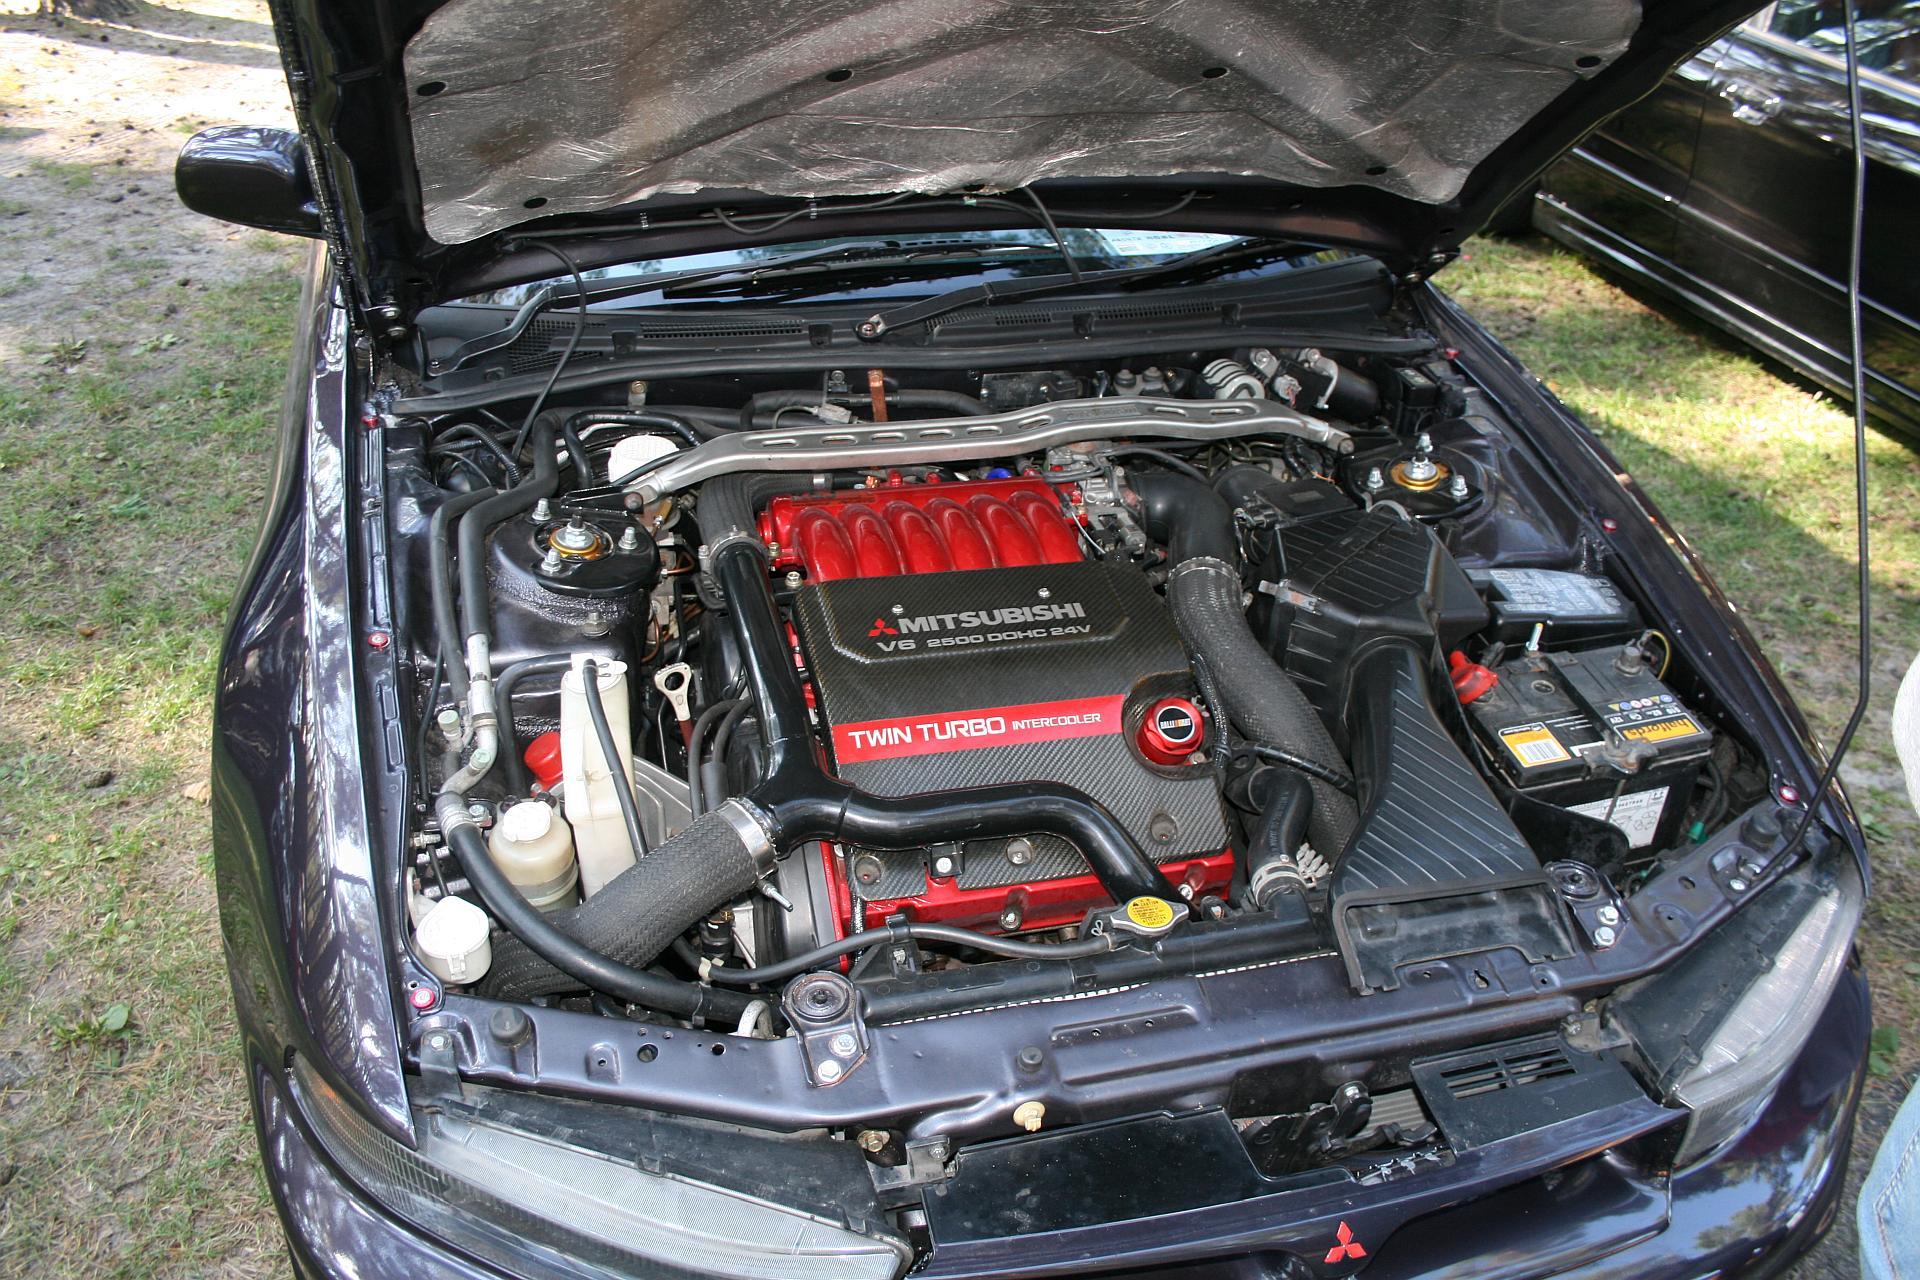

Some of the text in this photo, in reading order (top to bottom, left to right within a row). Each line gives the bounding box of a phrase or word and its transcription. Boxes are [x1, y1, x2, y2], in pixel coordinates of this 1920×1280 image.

[898, 603, 1086, 634] MITSUBISHI
[876, 624, 1091, 652] V6 2500 DOHC 24V
[847, 713, 1102, 749] TWIN TURBO INTERCOOLER
[1629, 719, 1689, 736] halfords
